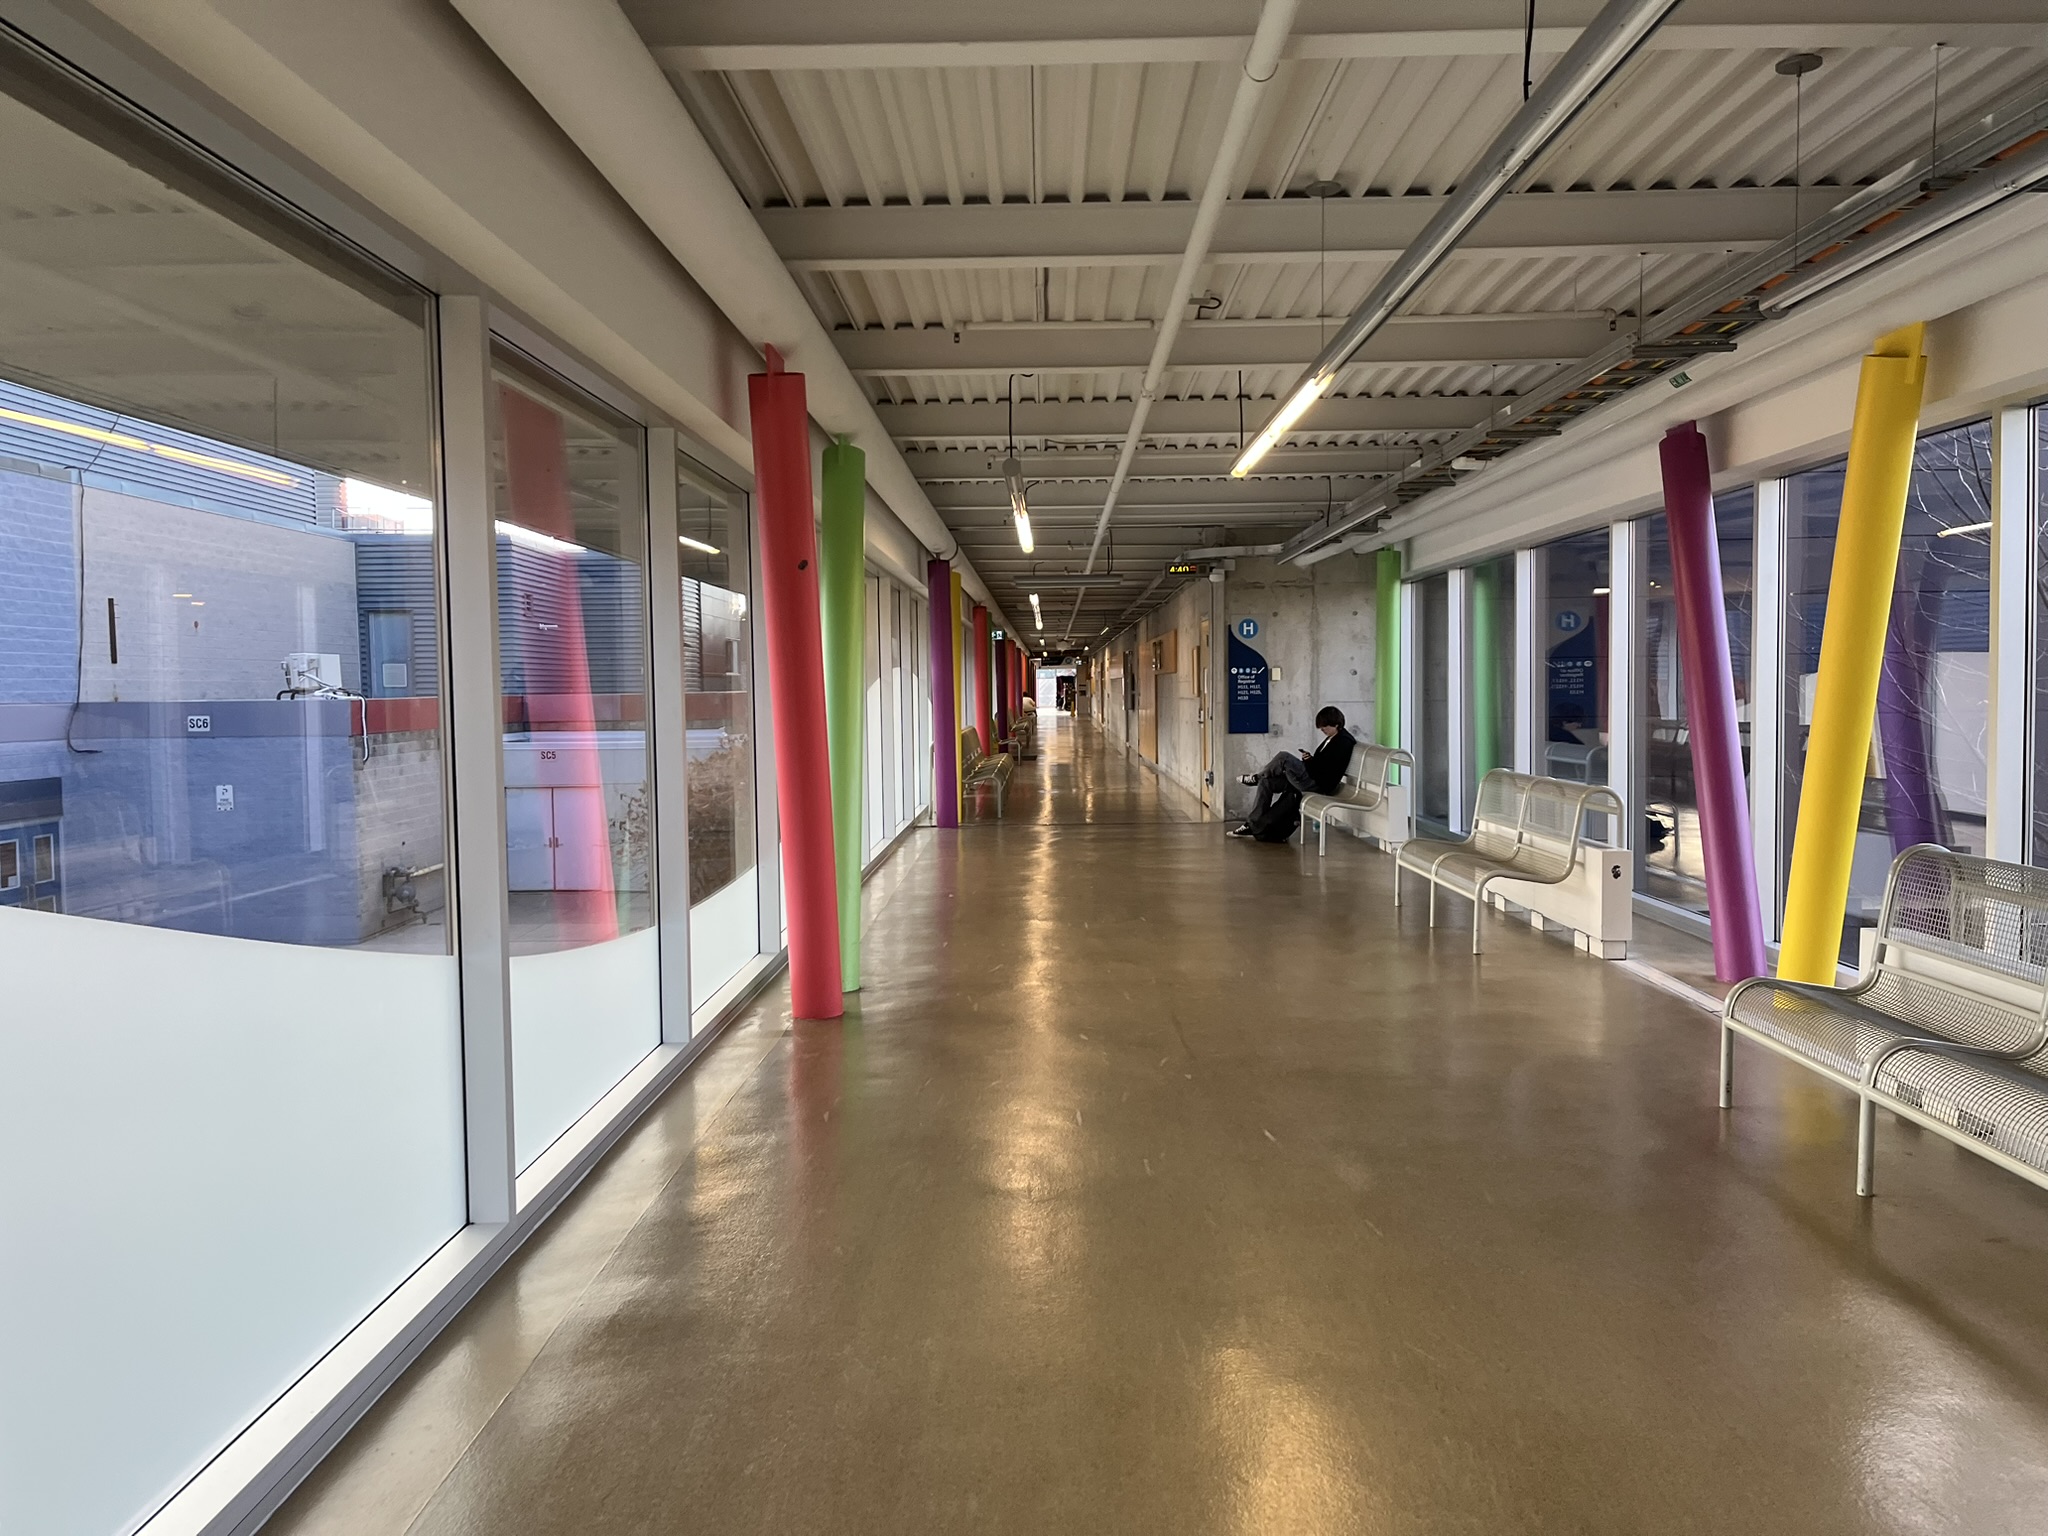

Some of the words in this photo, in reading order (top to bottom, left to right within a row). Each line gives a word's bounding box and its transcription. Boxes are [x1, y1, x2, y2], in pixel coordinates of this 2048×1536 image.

[1243, 622, 1253, 635] H
[189, 718, 208, 728] SC6
[541, 751, 556, 760] SC5
